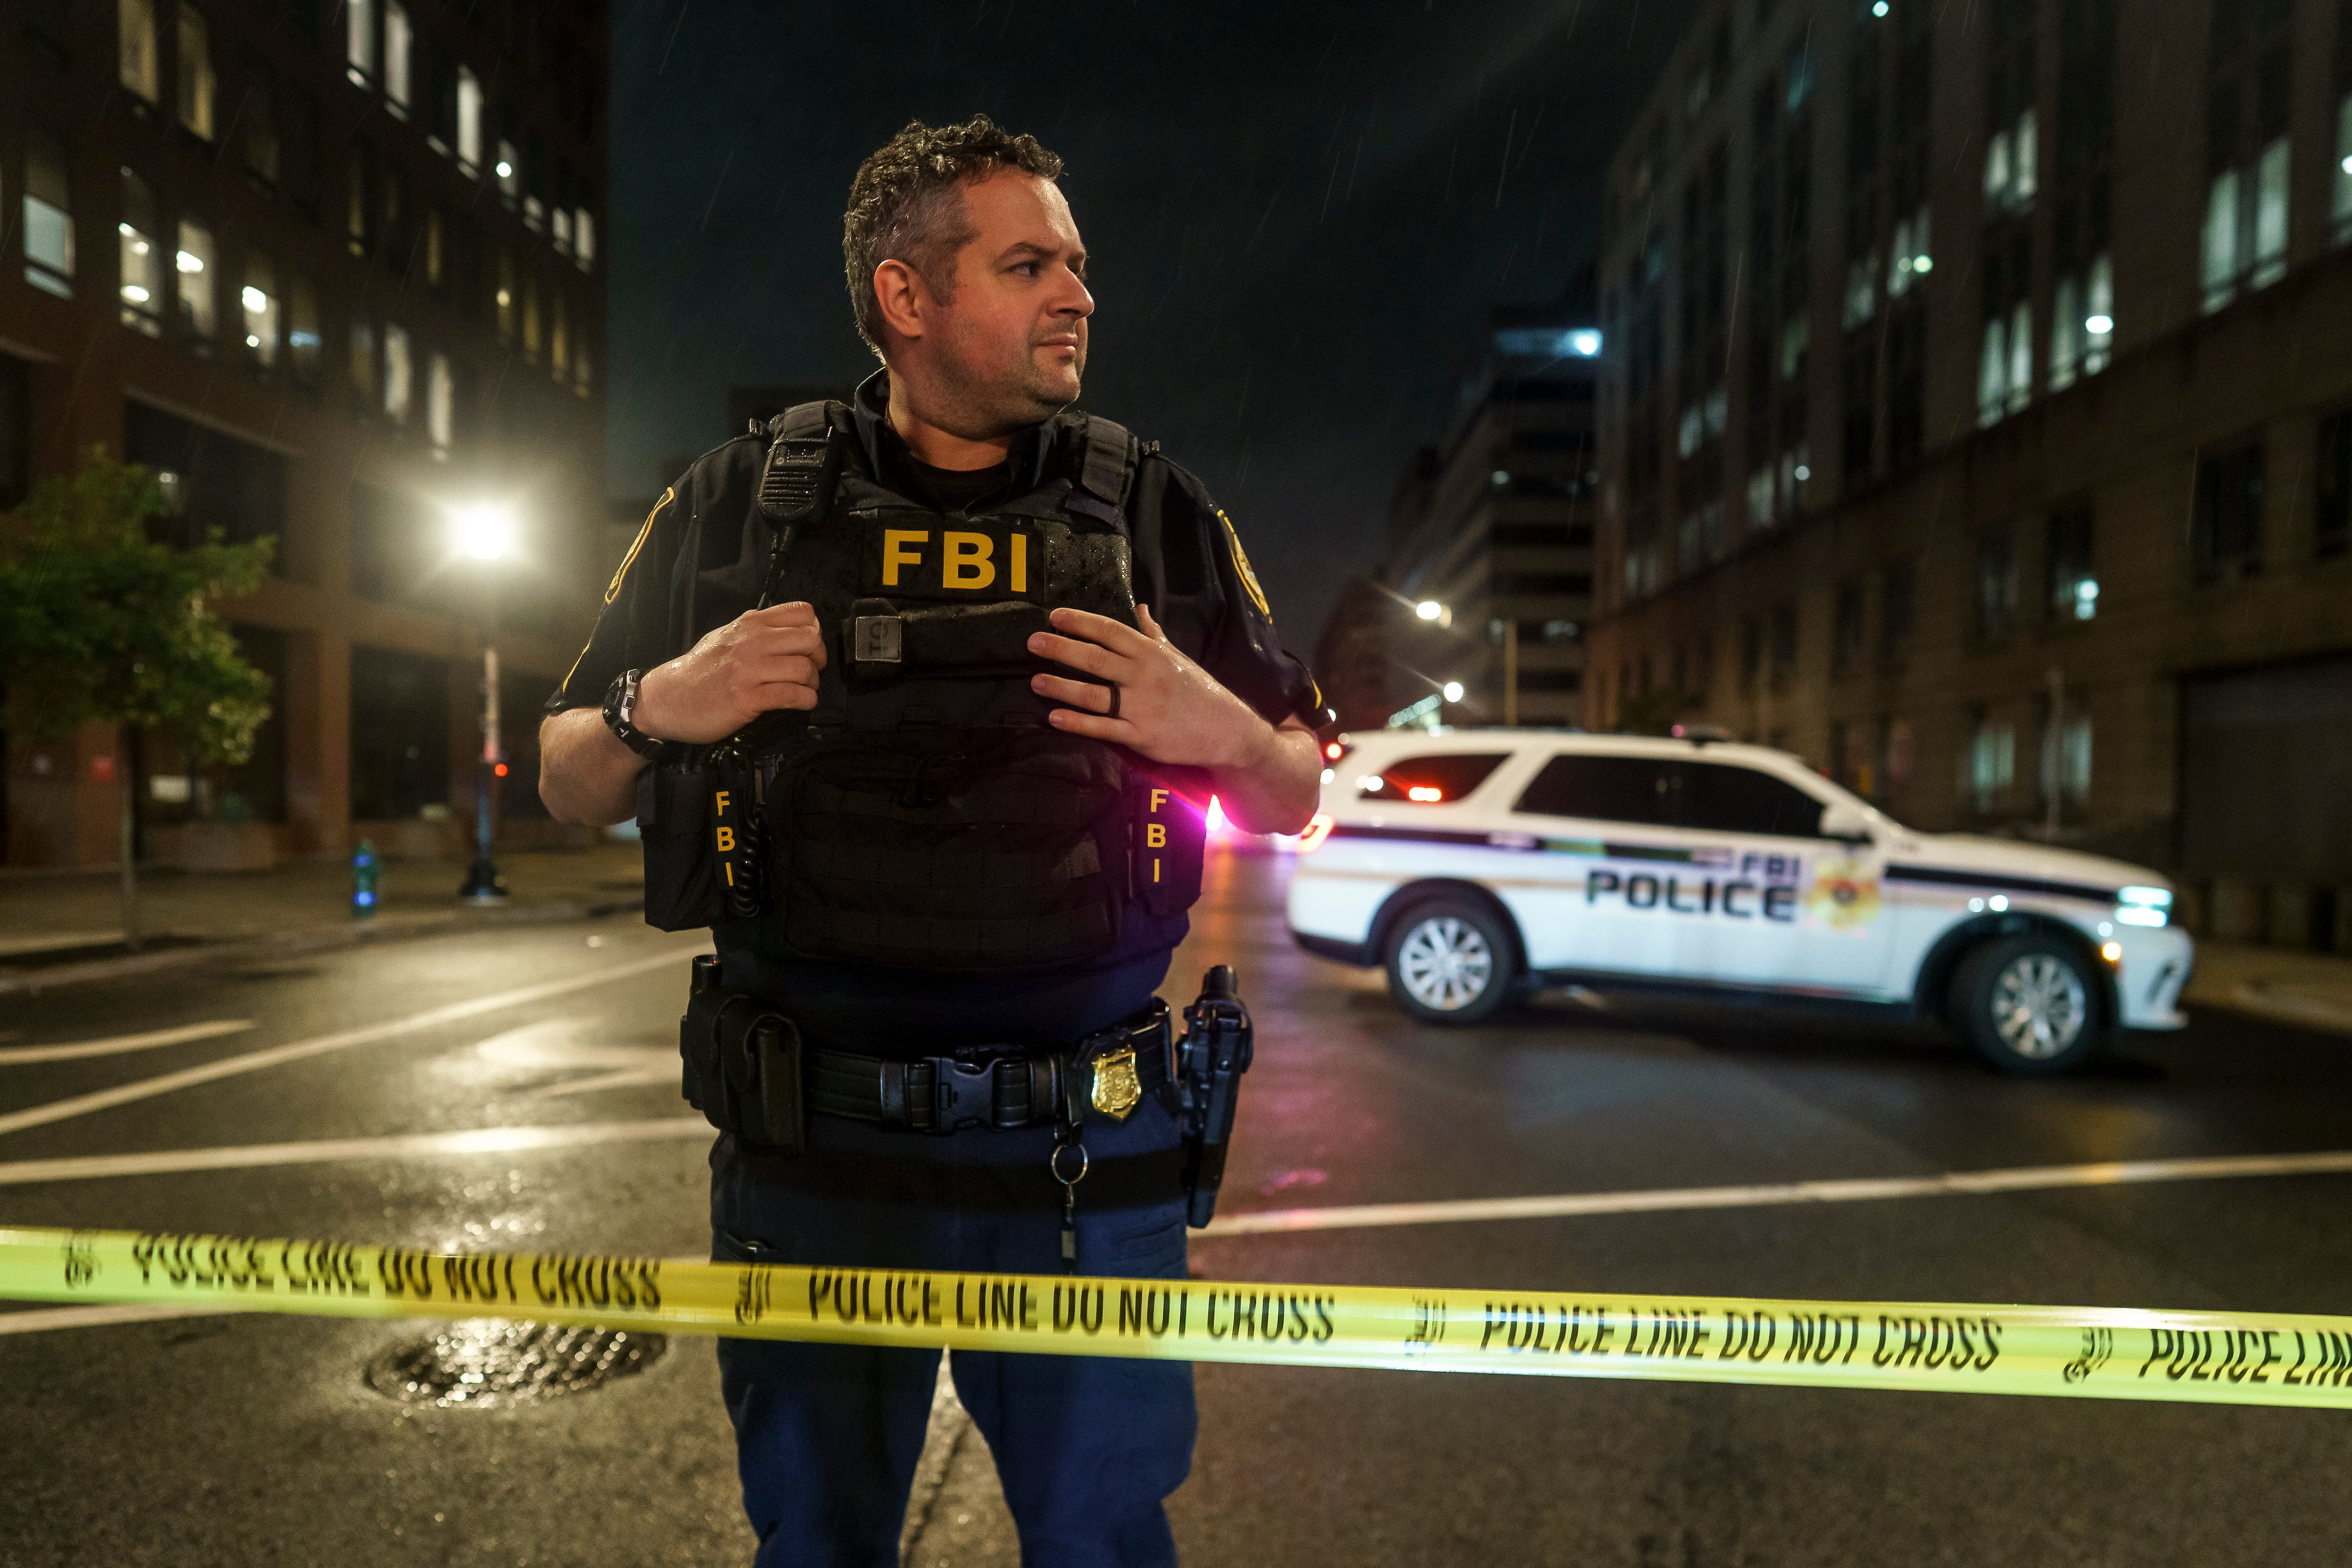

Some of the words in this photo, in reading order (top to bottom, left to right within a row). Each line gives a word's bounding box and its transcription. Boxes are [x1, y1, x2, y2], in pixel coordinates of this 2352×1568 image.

[882, 529, 1026, 592] FBI
[716, 791, 735, 886] FBI
[1147, 789, 1169, 883] FBI
[1741, 852, 1802, 878] FBI
[1585, 869, 1798, 923] POLICE
[132, 1233, 275, 1292] POLICE
[281, 1239, 371, 1297] LINE
[378, 1246, 432, 1301] DO
[532, 1254, 660, 1312] CROSS
[808, 1268, 942, 1327] POLICE
[956, 1274, 1037, 1332] LINE
[1053, 1279, 1104, 1336] DO
[1119, 1284, 1188, 1340] NOT
[1207, 1287, 1335, 1345] CROSS
[1480, 1301, 1614, 1356] POLICE
[1624, 1307, 1710, 1361] LINE
[1718, 1310, 1776, 1363] DO
[1782, 1313, 1859, 1366] NOT
[1872, 1315, 2002, 1372] CROSS
[2138, 1329, 2281, 1384] POLICE
